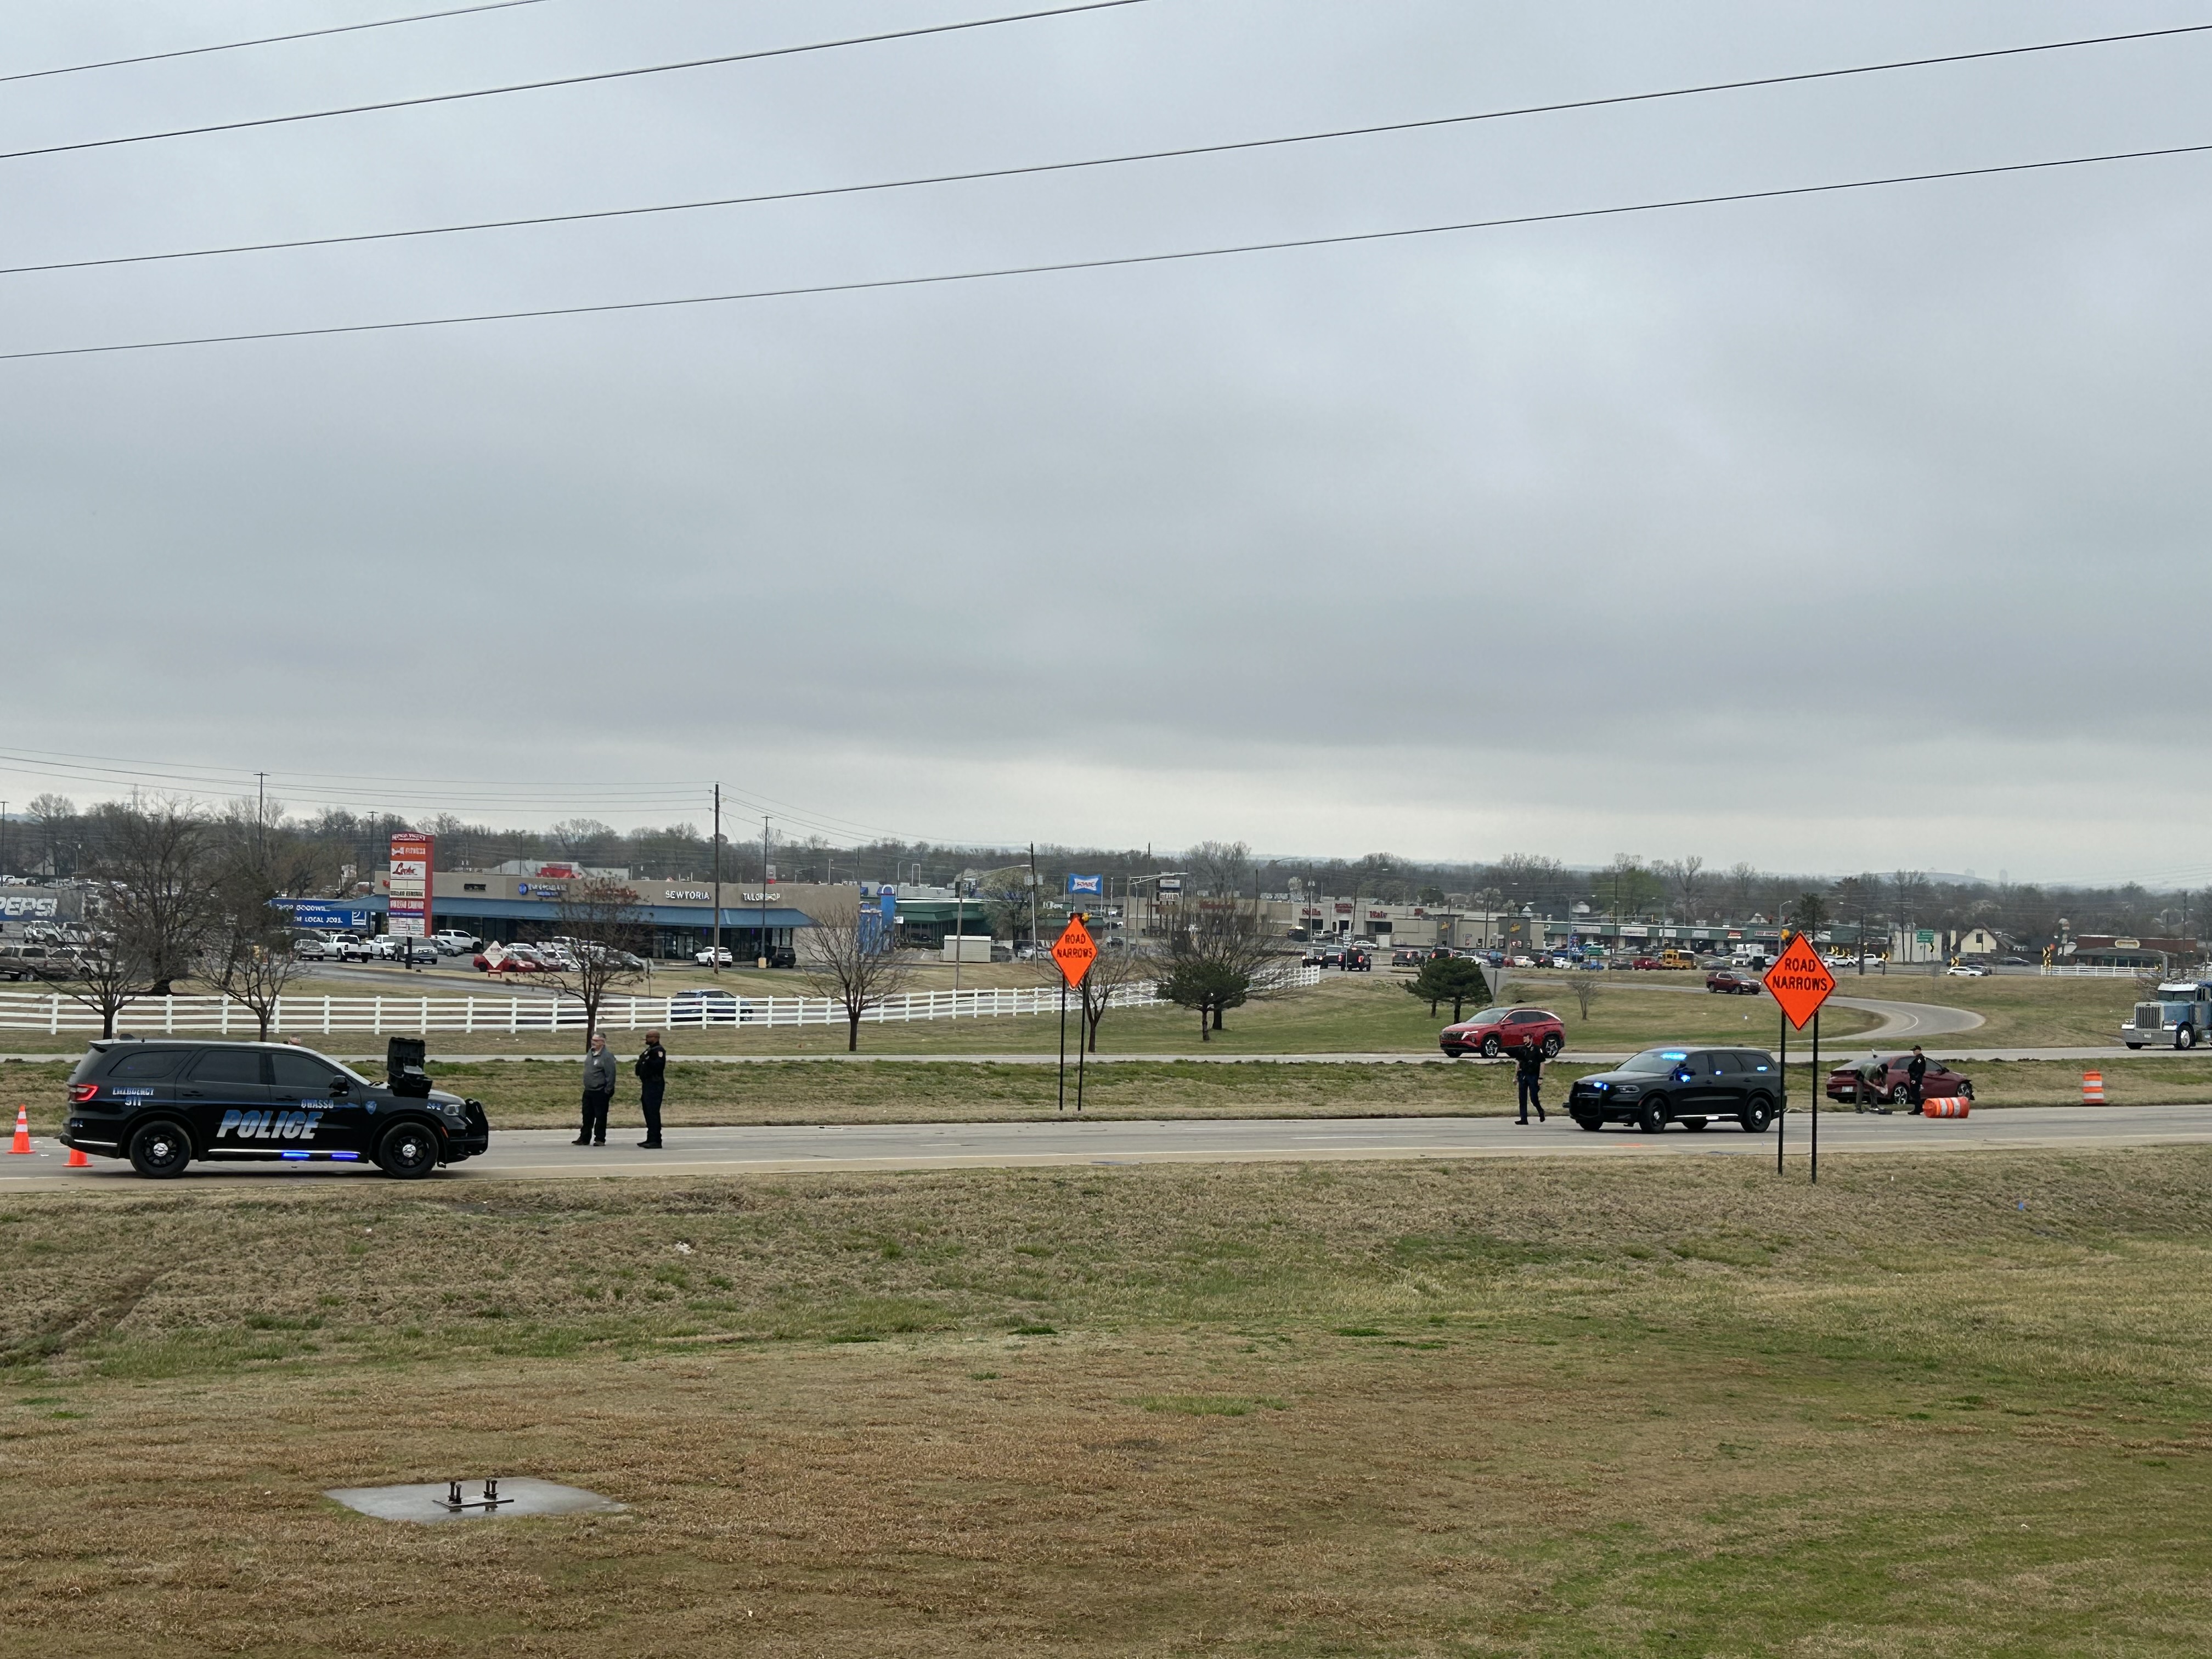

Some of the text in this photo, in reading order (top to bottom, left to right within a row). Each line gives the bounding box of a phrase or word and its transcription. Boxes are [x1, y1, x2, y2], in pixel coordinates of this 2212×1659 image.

[1065, 934, 1086, 944] ROAD
[1057, 947, 1092, 958] NARROWS
[1785, 957, 1816, 972] ROAD
[1773, 975, 1827, 991] NARROWS
[125, 1096, 141, 1107] 911
[216, 1109, 324, 1139] POLICE
